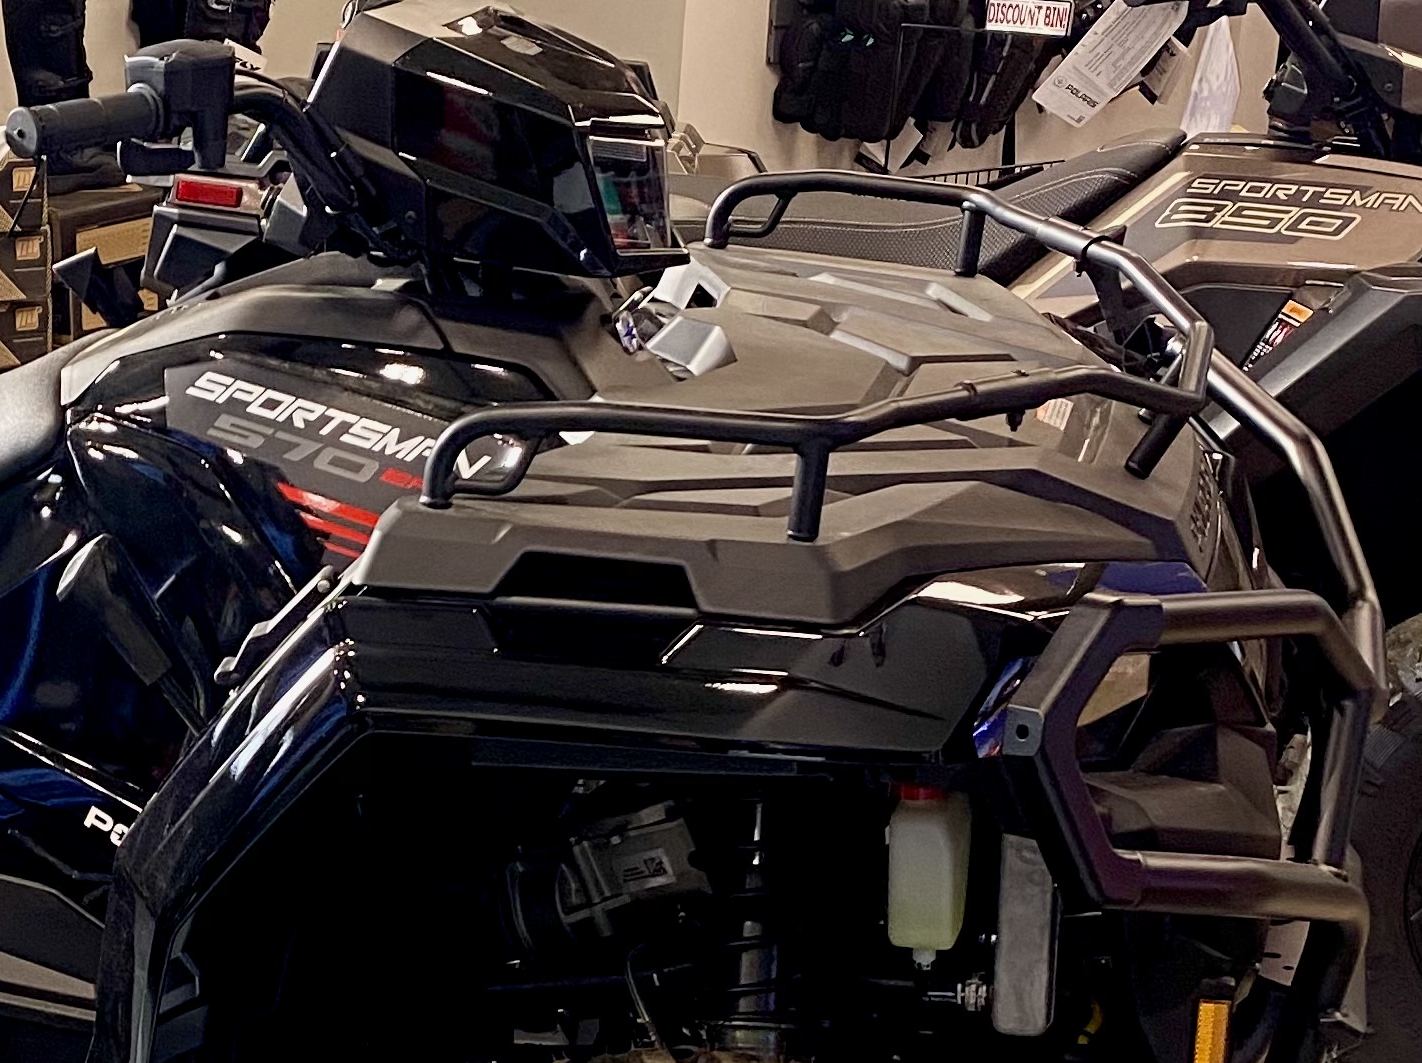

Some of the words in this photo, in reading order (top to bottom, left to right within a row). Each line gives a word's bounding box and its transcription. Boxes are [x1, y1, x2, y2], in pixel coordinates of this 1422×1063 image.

[987, 2, 1043, 27] DISCOUNT
[1043, 5, 1068, 29] BIN!
[1065, 83, 1099, 109] POLARIS
[1154, 198, 1362, 241] 850
[206, 412, 380, 484] 570
